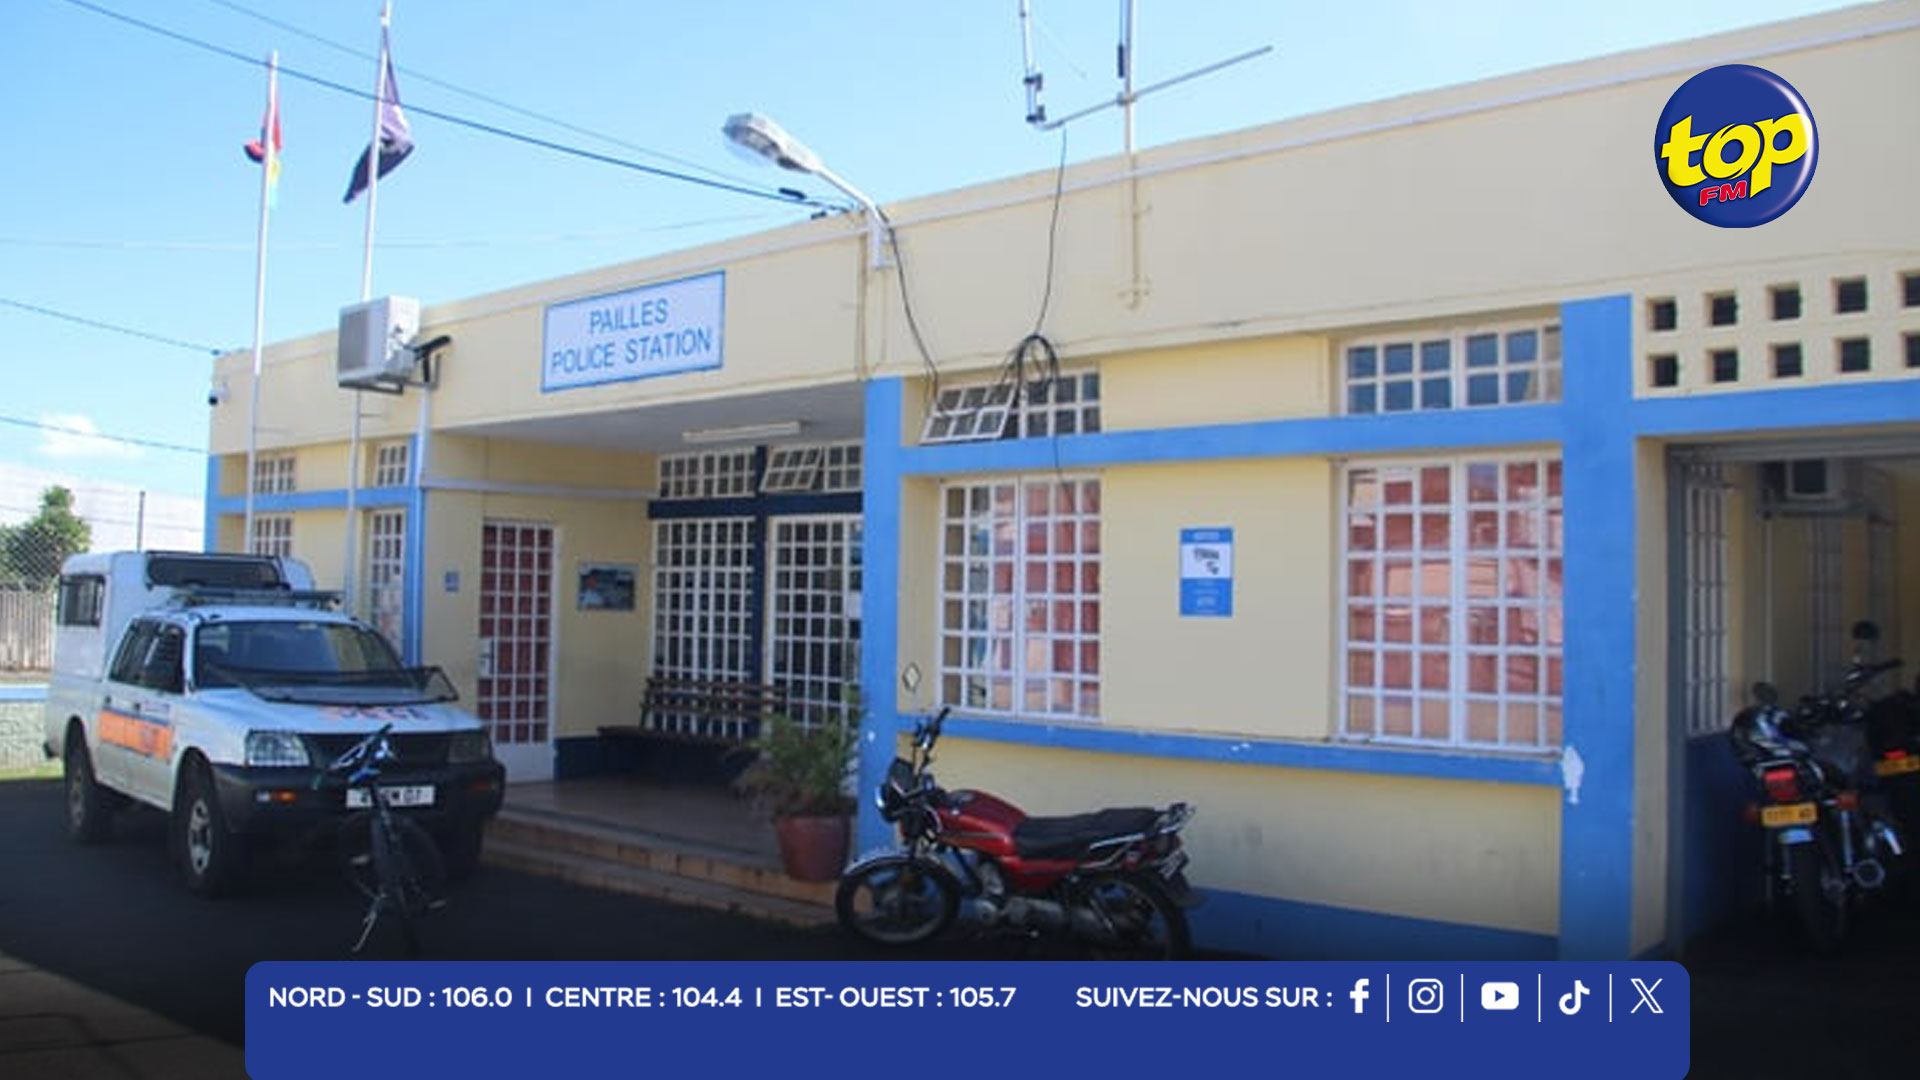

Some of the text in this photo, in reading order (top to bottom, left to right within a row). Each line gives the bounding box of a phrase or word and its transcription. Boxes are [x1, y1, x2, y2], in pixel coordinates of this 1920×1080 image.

[589, 298, 669, 334] PAILLES
[551, 327, 712, 374] POLICE STATION
